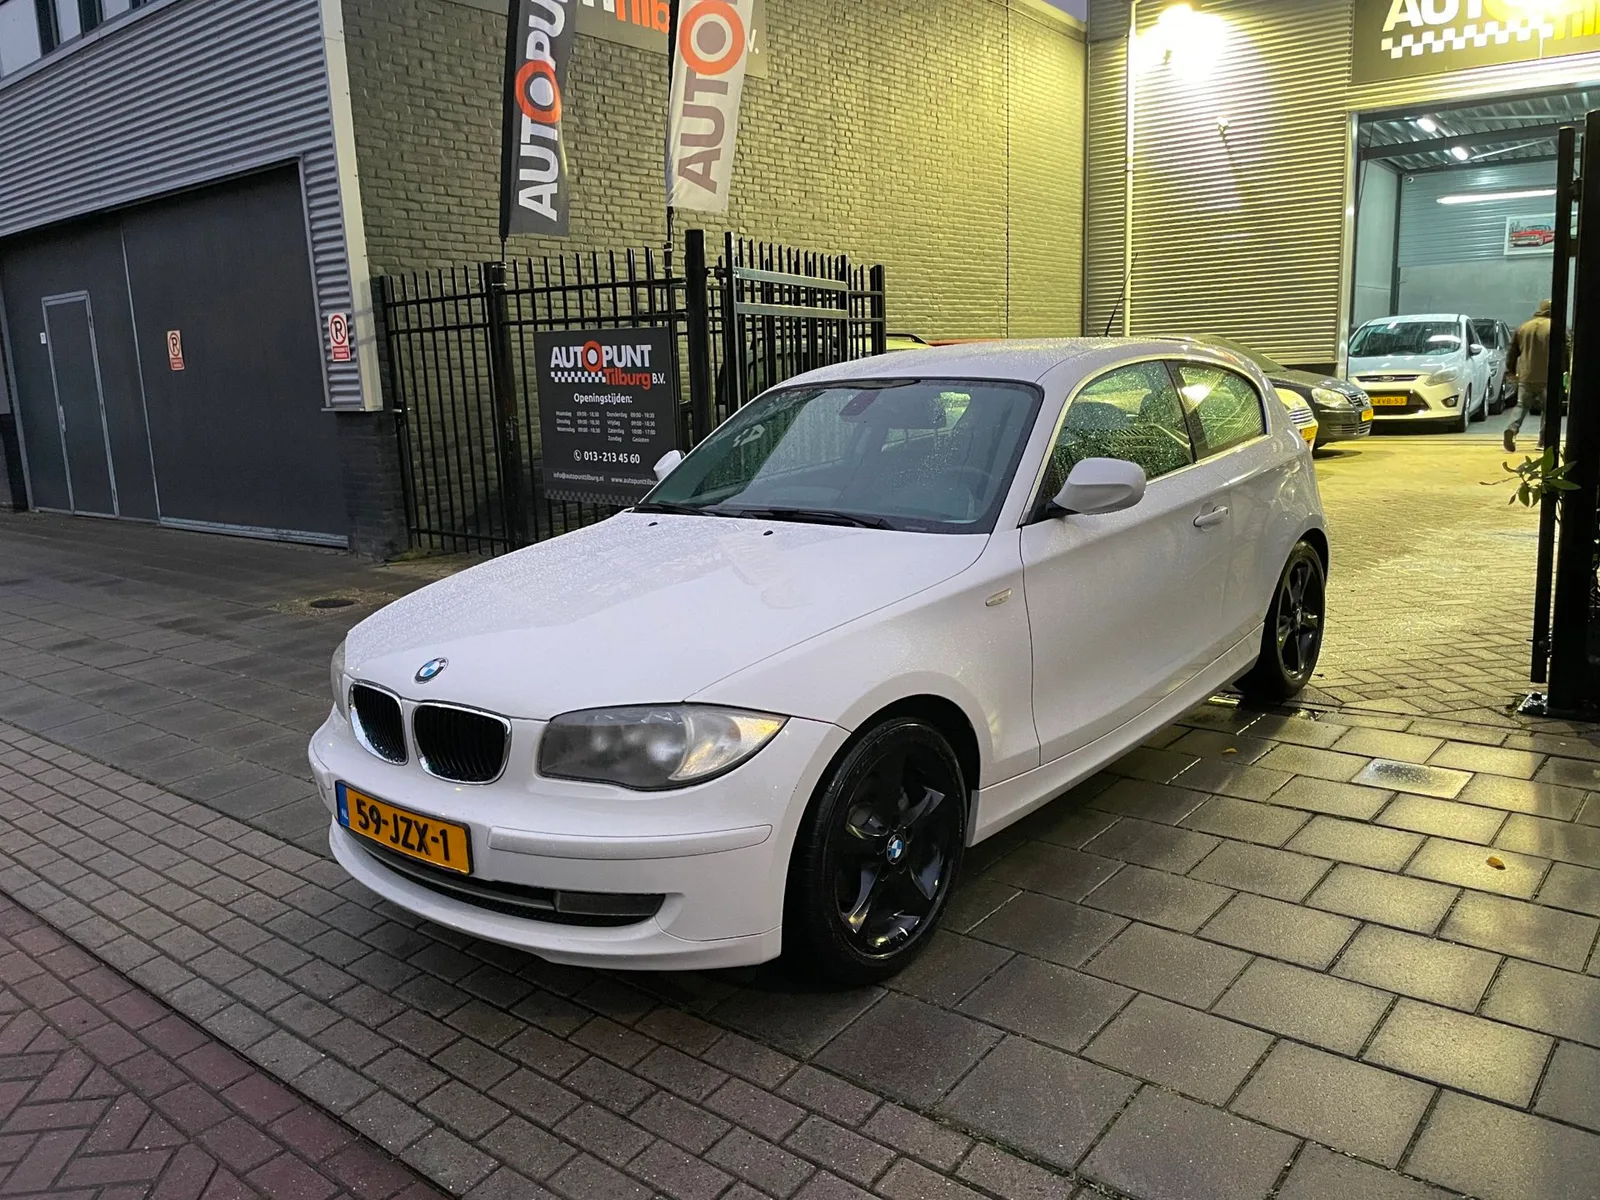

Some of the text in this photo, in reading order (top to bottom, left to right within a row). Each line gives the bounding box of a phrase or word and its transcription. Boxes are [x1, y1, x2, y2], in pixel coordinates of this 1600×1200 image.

[515, 0, 569, 222] AUTOPU
[677, 0, 746, 195] AUTO
[550, 340, 652, 372] AUTOPUNT
[603, 368, 666, 390] Tilburg B.V.
[573, 393, 633, 405] Openingstijden:
[618, 453, 629, 463] 45
[629, 453, 641, 464] 60
[355, 797, 450, 862] 59-JZX-1
